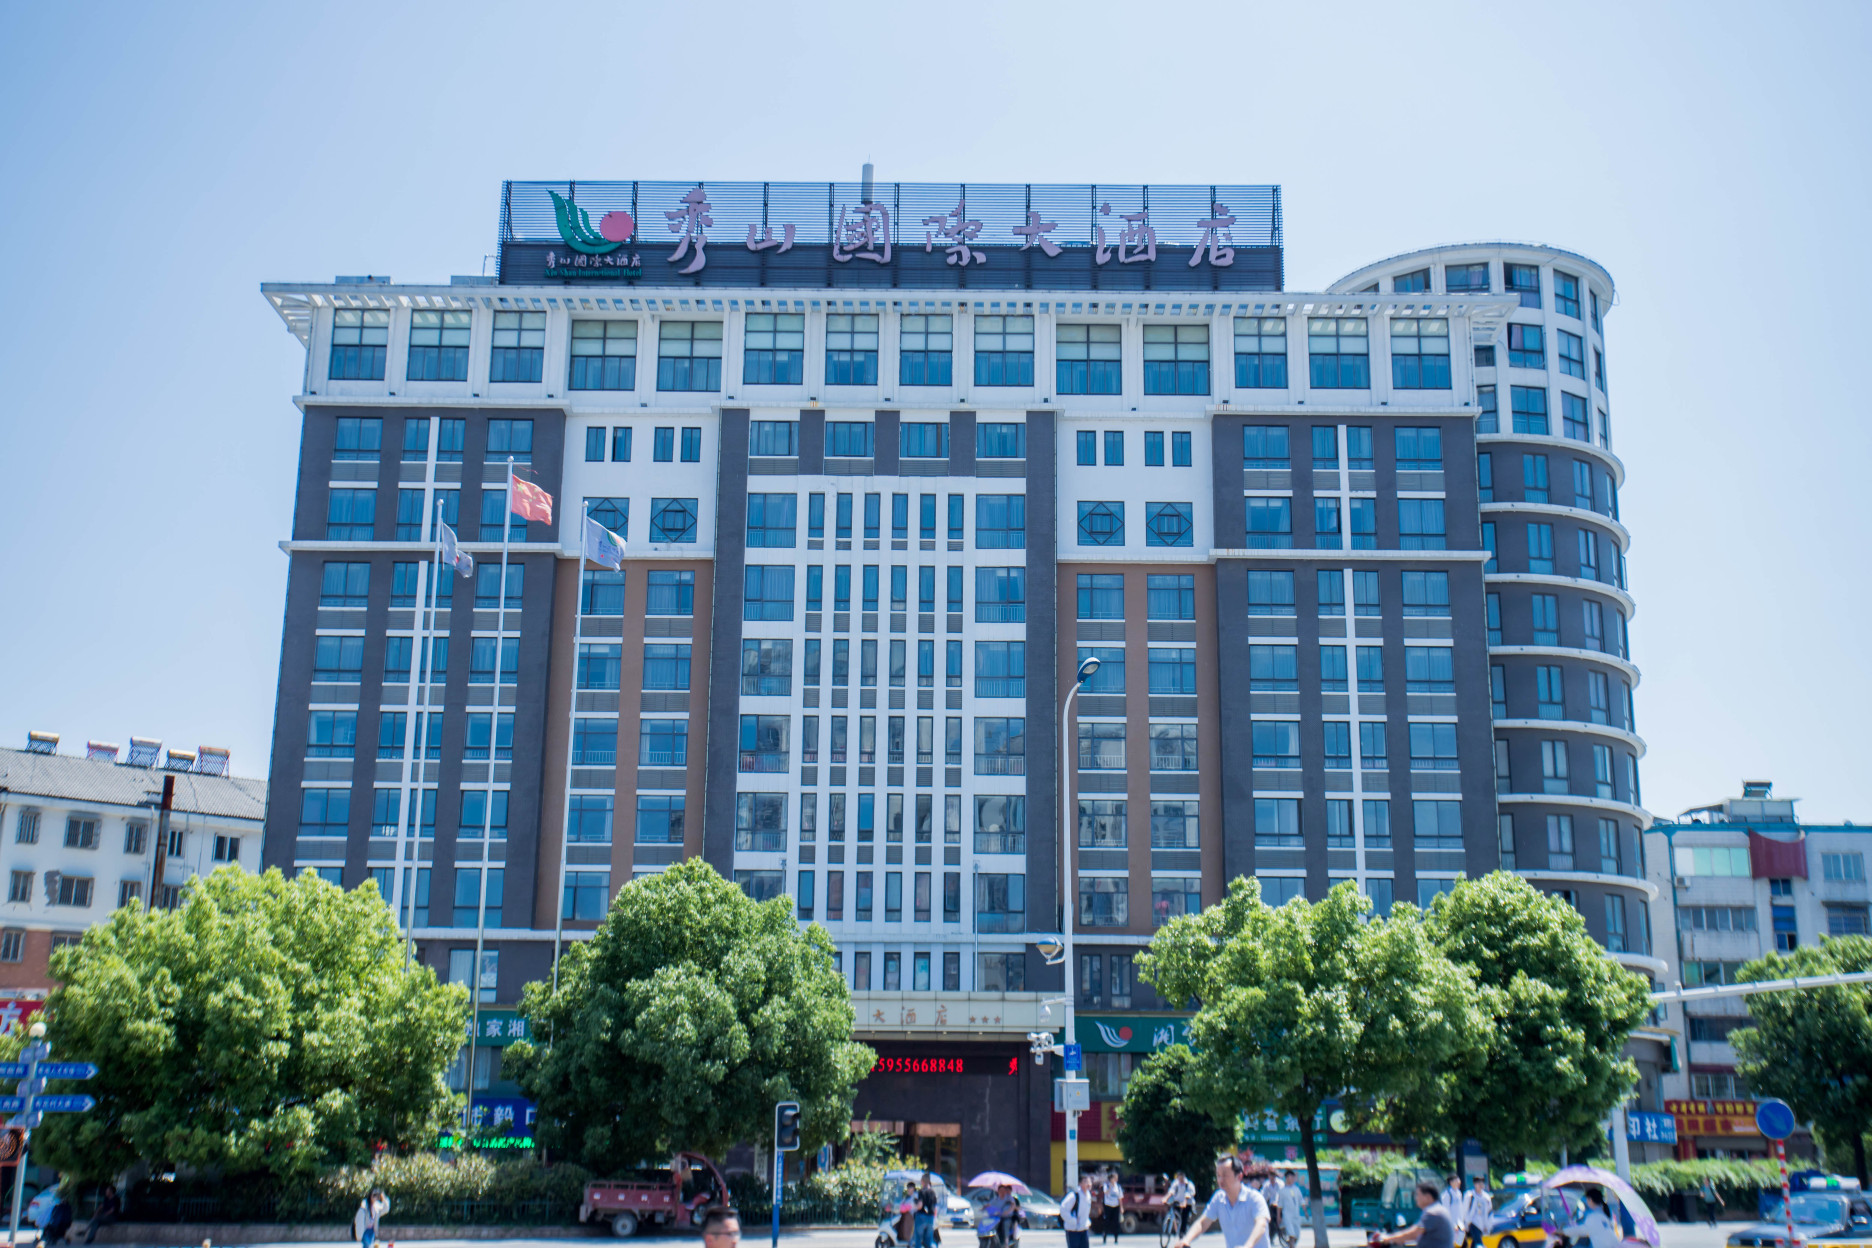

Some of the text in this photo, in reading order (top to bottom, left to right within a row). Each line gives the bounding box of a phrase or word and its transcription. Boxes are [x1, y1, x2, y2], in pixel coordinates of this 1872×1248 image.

[578, 268, 621, 277] International
[623, 268, 643, 277] Hotel
[873, 1004, 948, 1026] 大酒店
